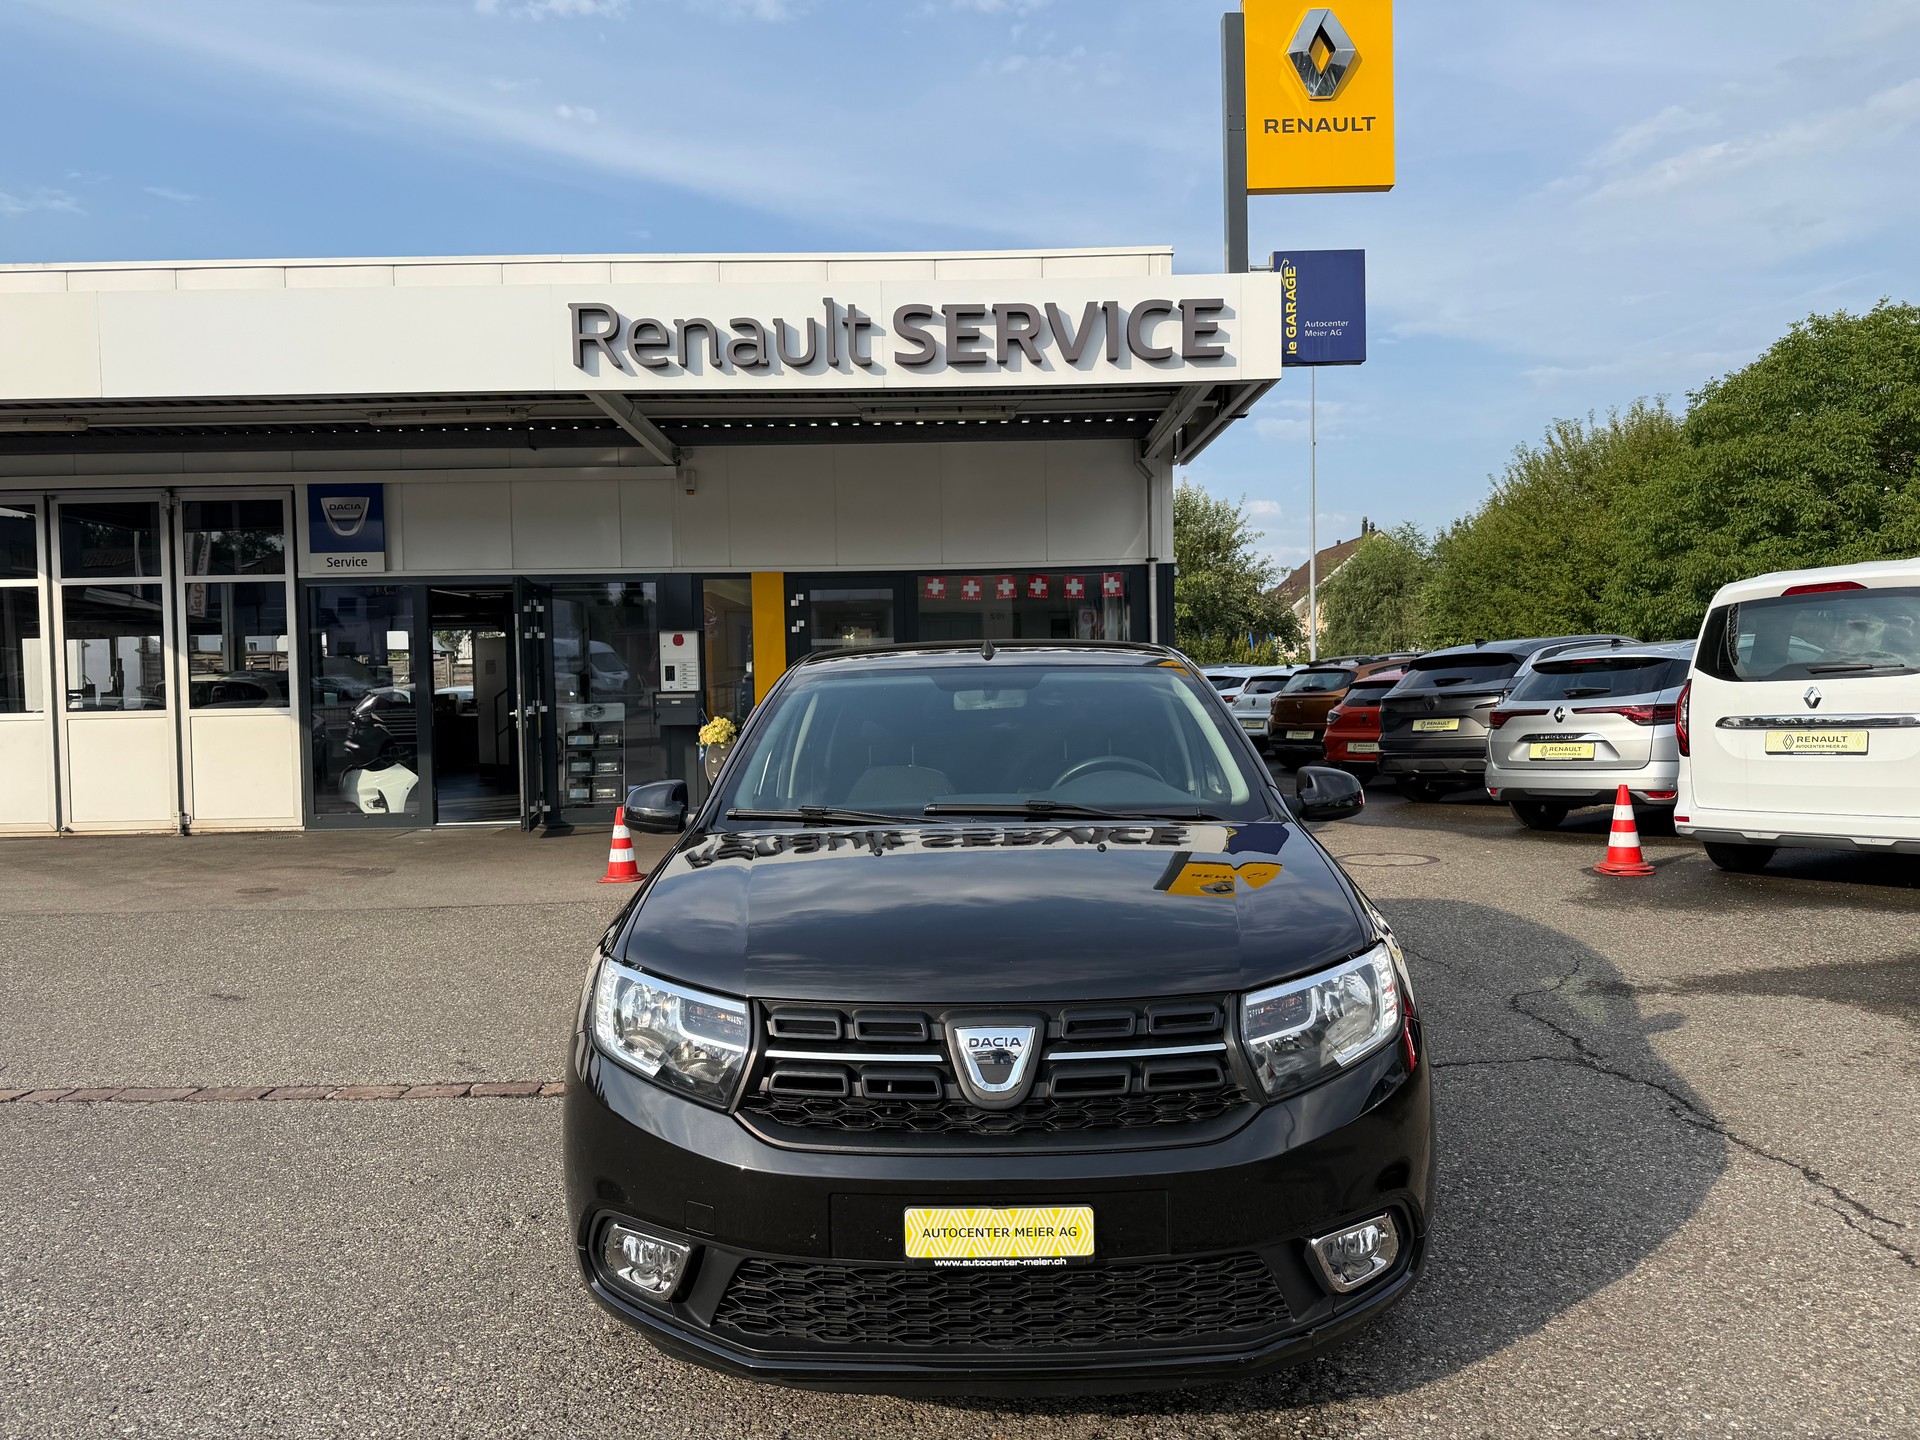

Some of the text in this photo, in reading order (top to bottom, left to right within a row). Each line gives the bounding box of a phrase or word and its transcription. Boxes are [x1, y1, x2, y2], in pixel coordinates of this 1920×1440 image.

[1264, 116, 1376, 134] RENAULT
[1285, 265, 1297, 355] le GARAGE
[1304, 320, 1349, 328] Autocenter
[567, 297, 1225, 369] Renault SERVICE
[1304, 329, 1327, 337] Meier
[329, 503, 361, 511] DACIA
[326, 556, 368, 568] Service
[1796, 735, 1848, 743] RENAULT
[968, 1037, 1022, 1048] DACIA
[922, 1226, 1077, 1238] AUTOCENTER MEIER AG
[934, 1257, 1067, 1267] www.autocenter-meier.ch
